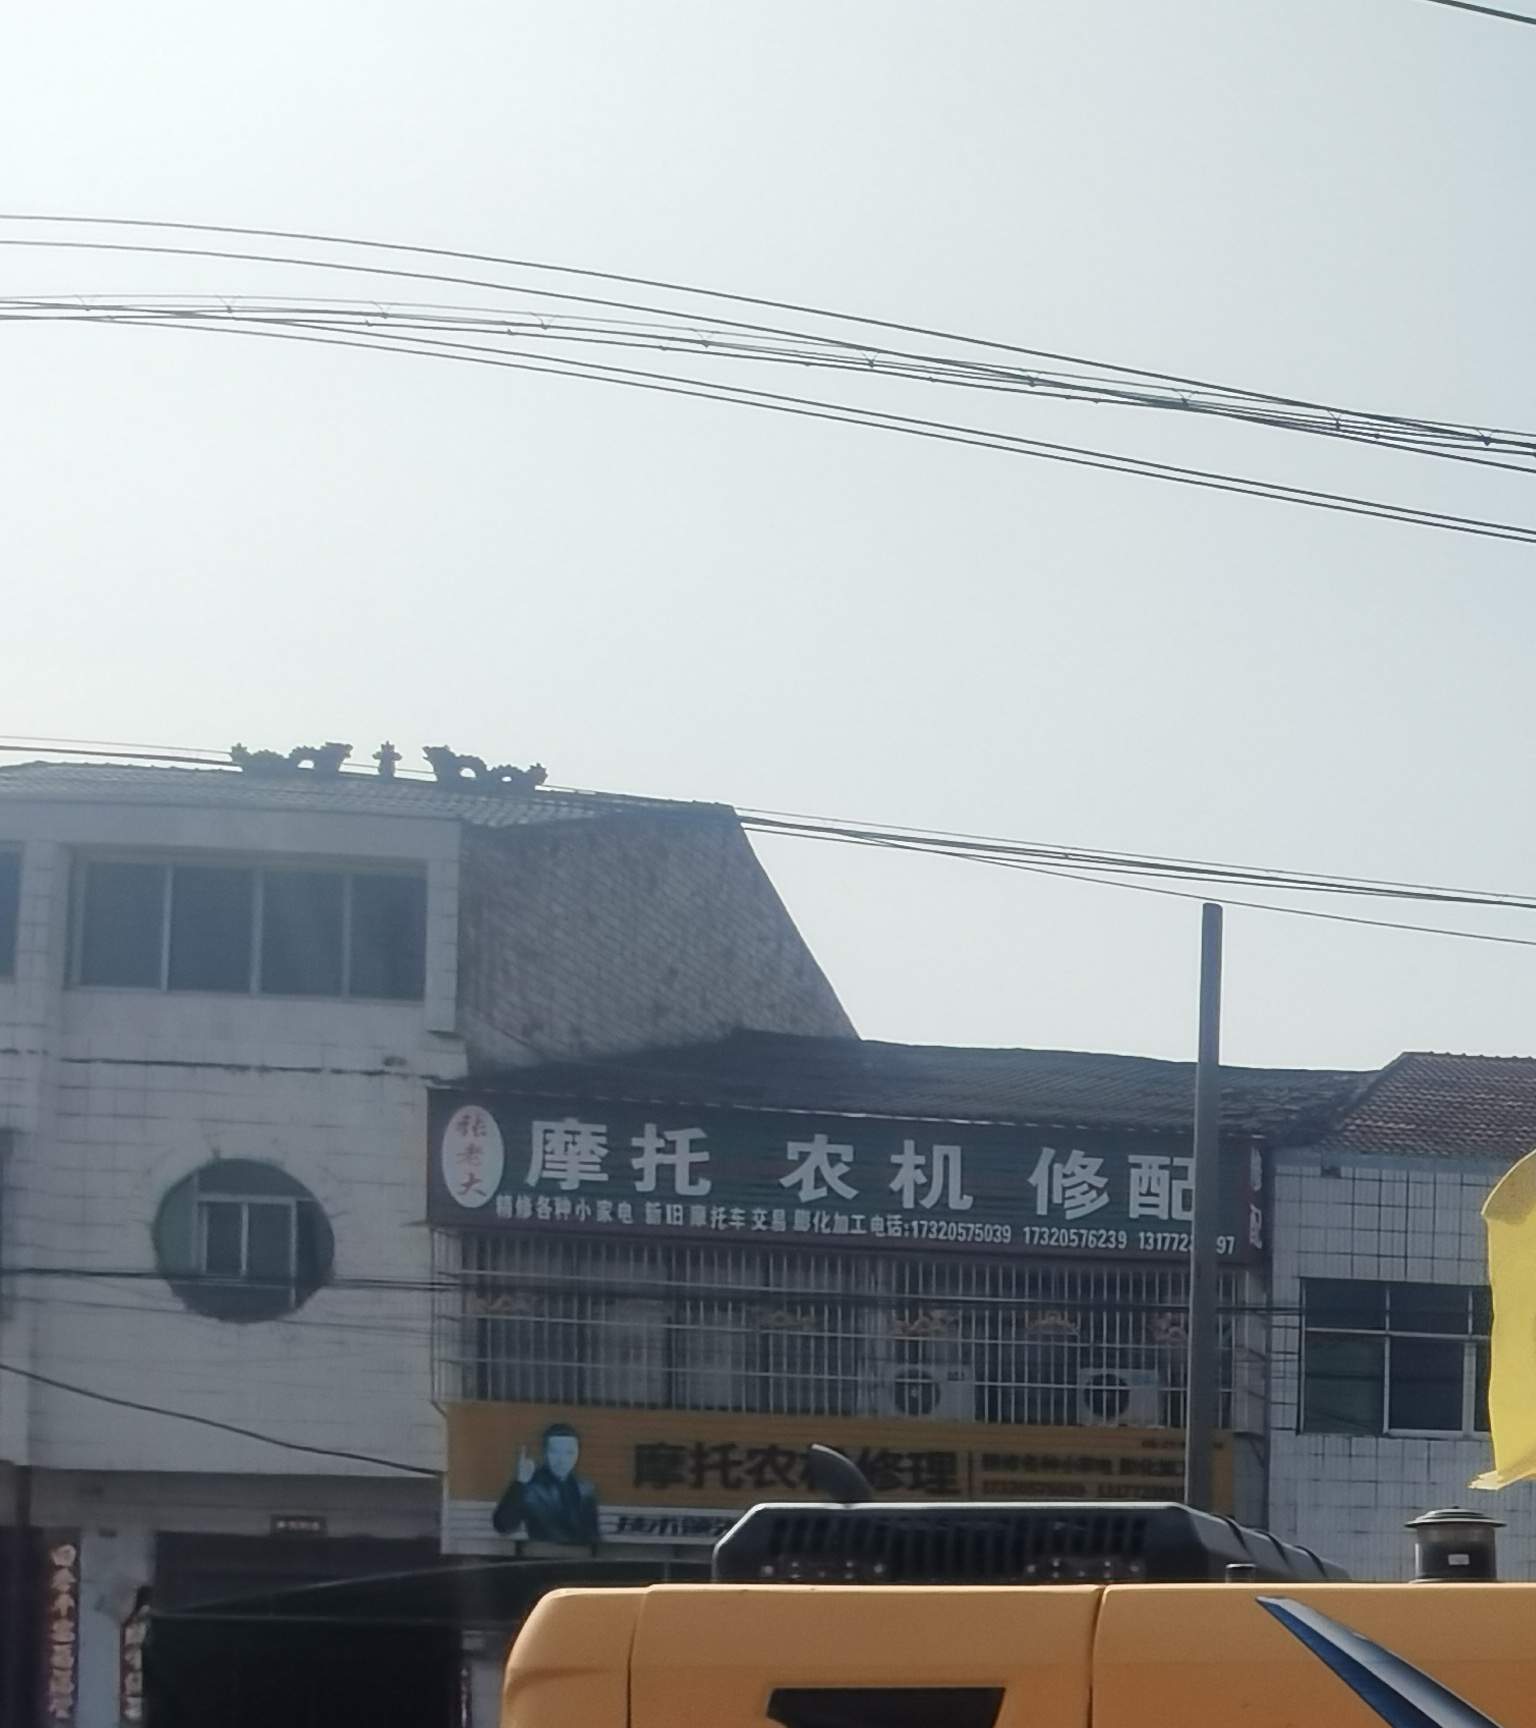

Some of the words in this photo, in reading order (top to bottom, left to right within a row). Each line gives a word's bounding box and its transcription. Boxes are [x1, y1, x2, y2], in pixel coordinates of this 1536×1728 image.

[525, 1117, 712, 1197] 摩托
[780, 1134, 974, 1211] 农机
[1023, 1226, 1127, 1250] 17320576239
[634, 1443, 960, 1494] 摩托农修理
